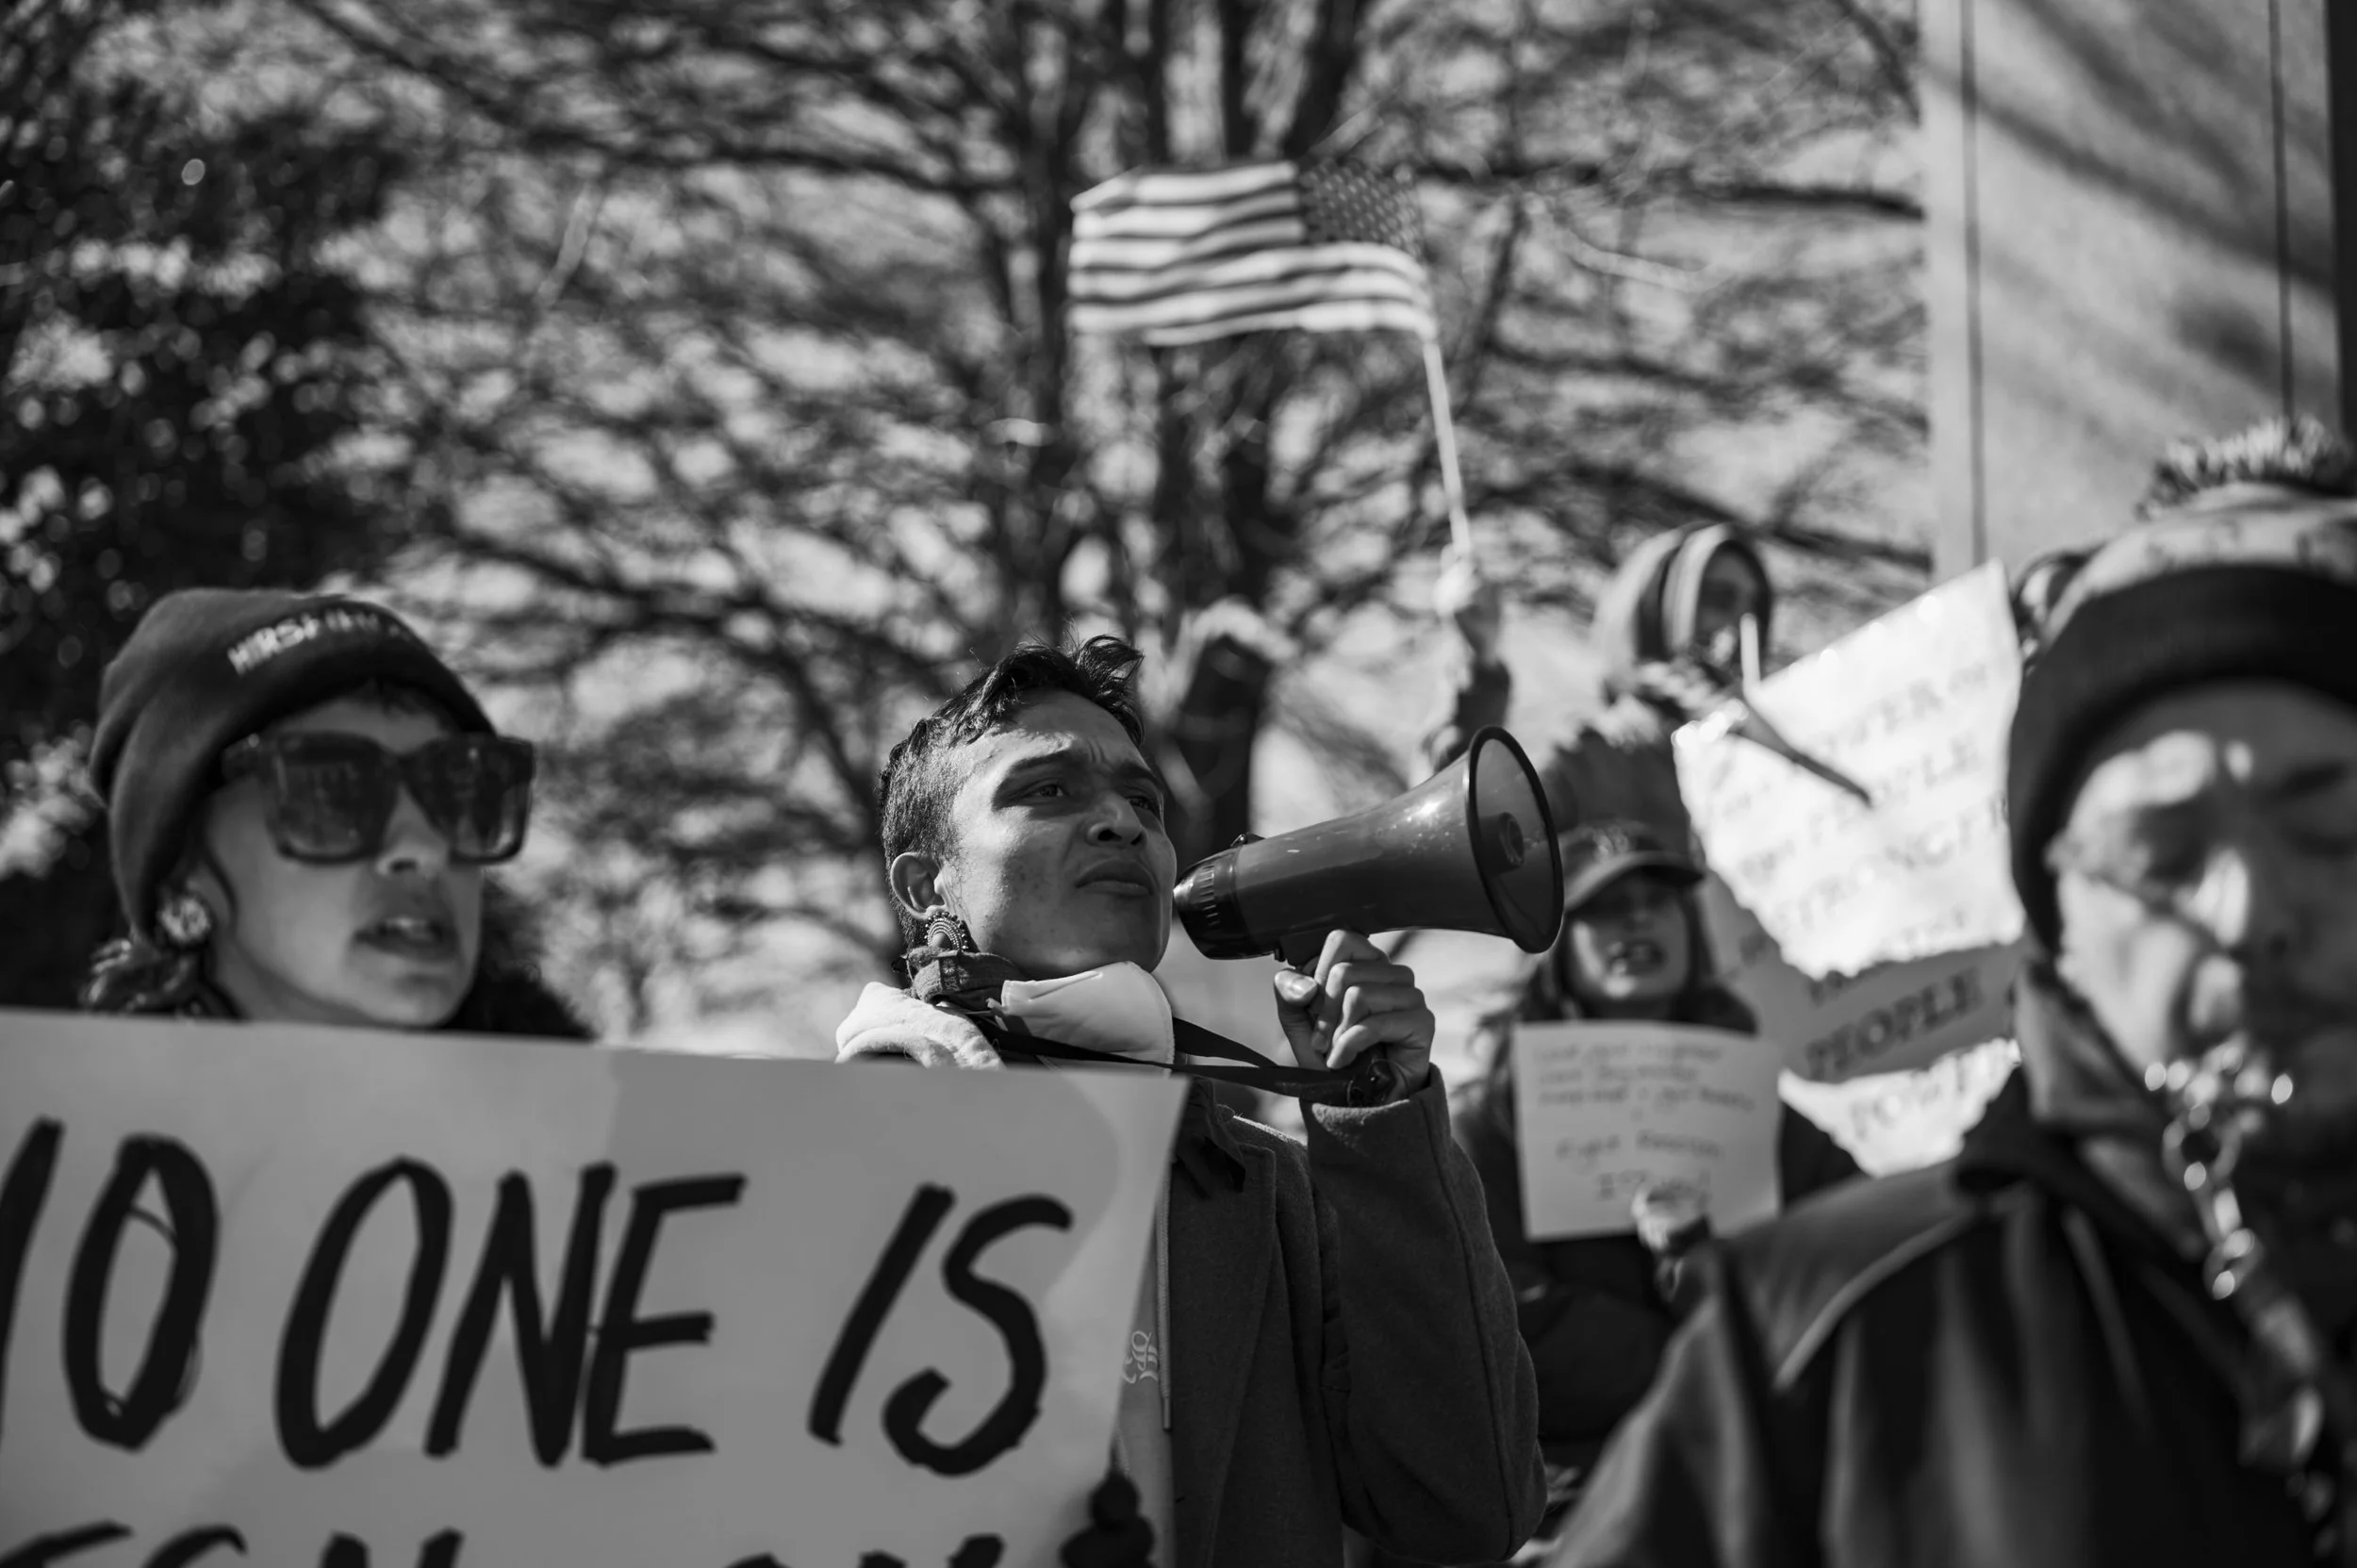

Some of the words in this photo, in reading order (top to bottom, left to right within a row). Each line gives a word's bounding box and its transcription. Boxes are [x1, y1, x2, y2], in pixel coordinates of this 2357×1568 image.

[1805, 966, 1983, 1081] PEOPLE
[273, 1157, 748, 1472] ONE
[807, 1182, 1074, 1478] IS
